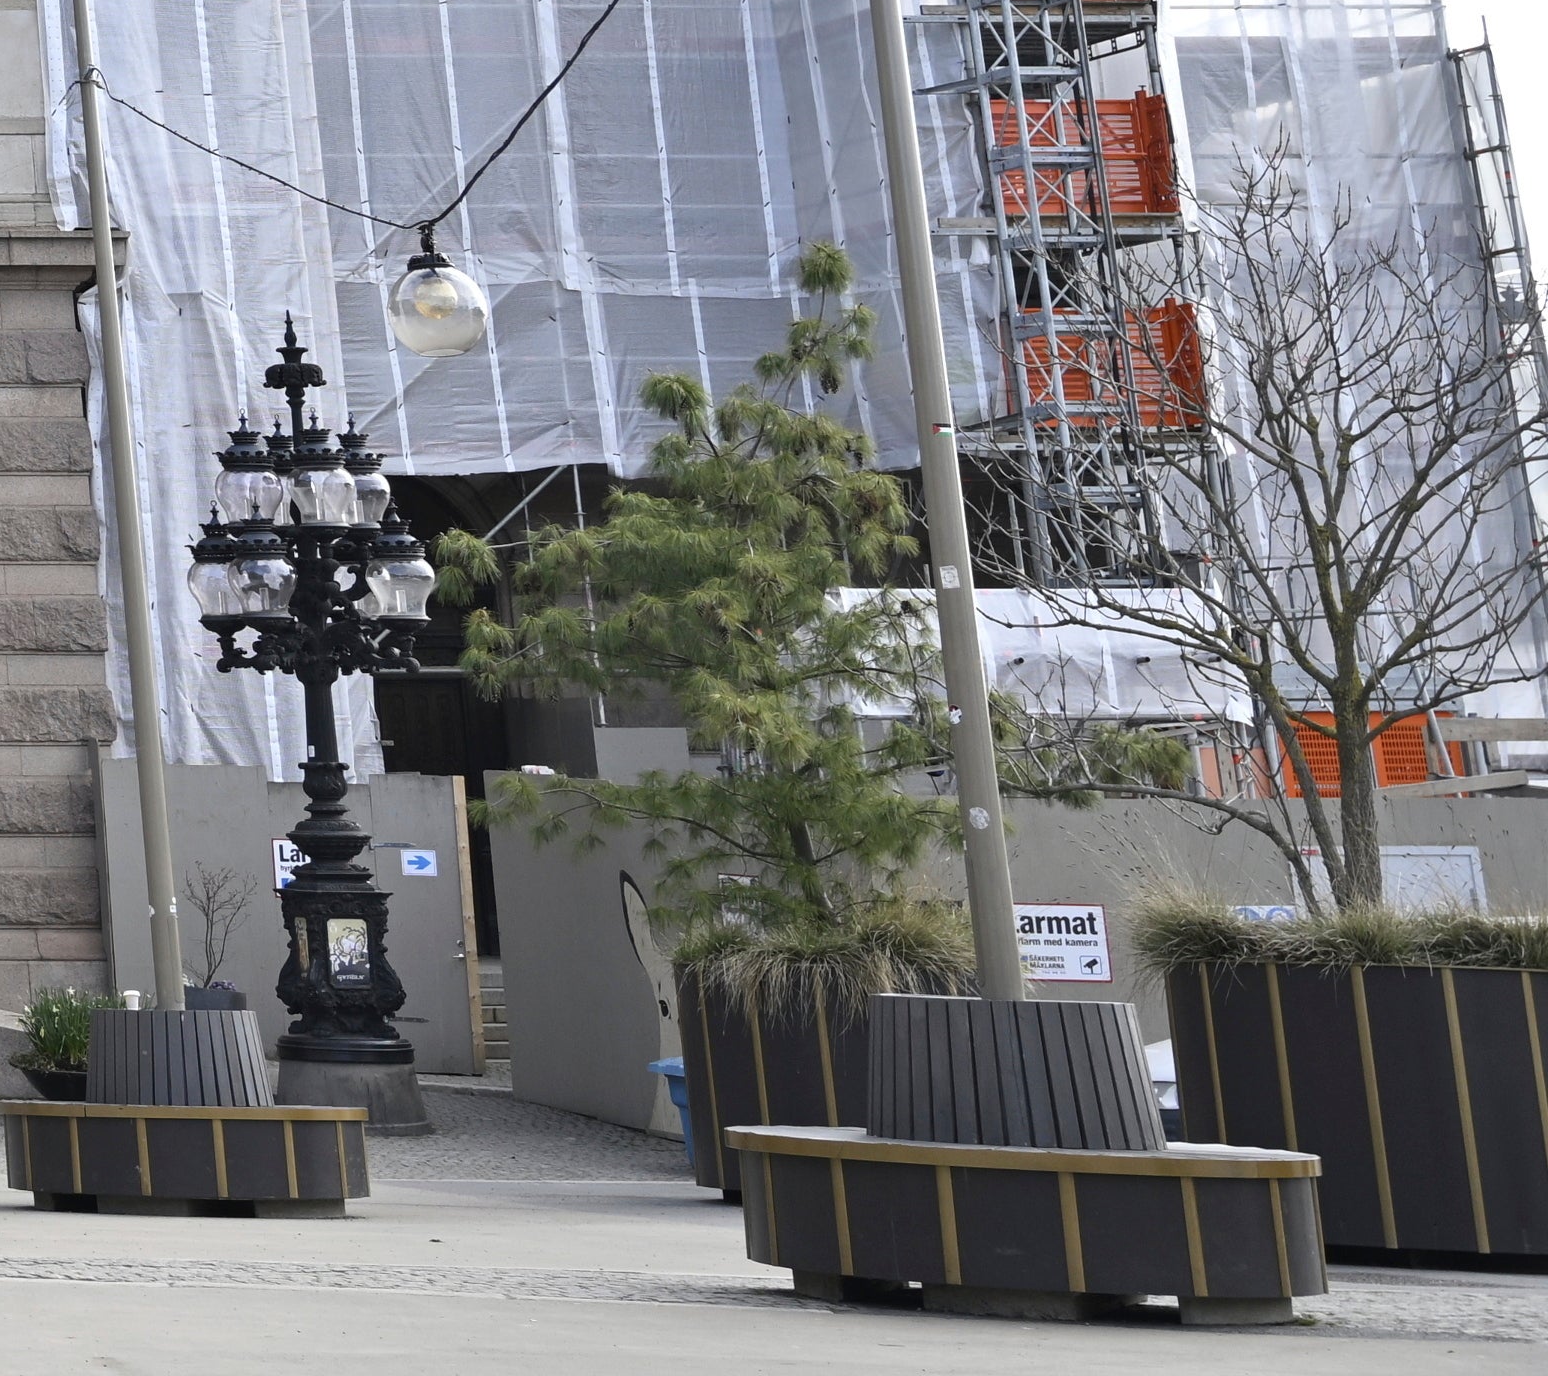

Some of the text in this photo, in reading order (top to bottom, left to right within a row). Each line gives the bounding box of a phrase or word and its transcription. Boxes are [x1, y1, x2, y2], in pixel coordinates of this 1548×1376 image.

[1017, 912, 1098, 935] armat
[1044, 938, 1063, 946] med
[1065, 938, 1099, 947] kamera
